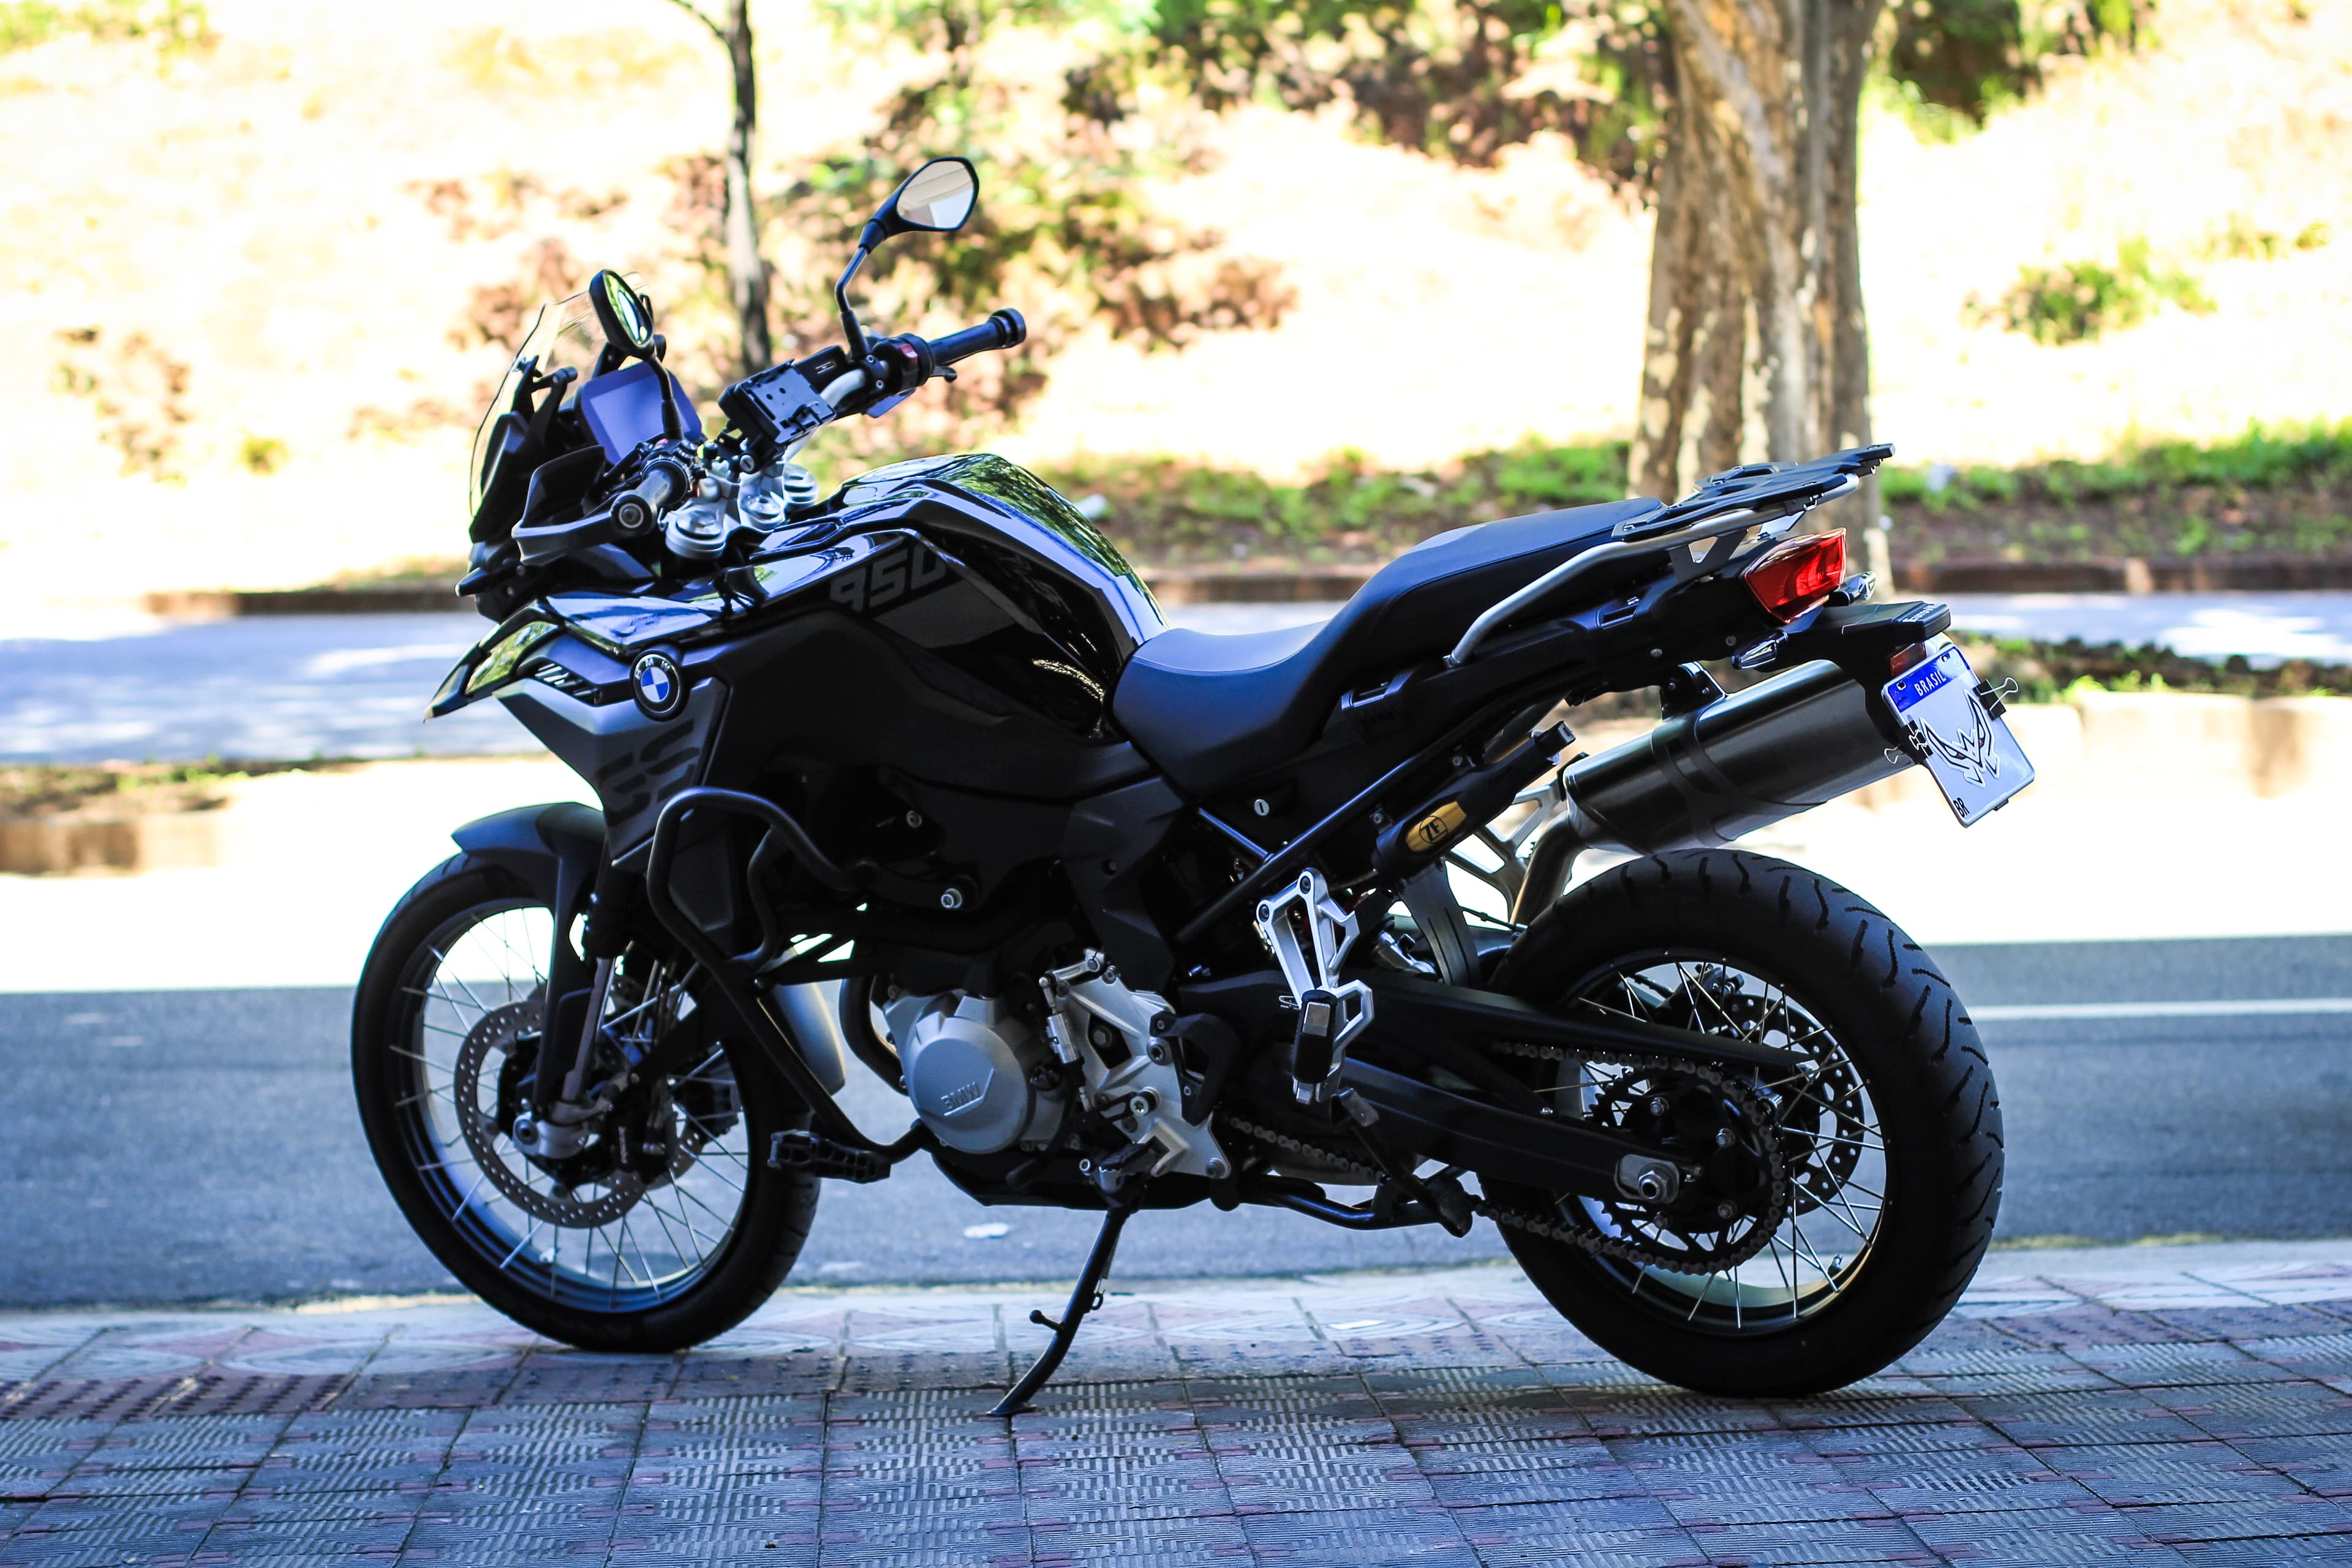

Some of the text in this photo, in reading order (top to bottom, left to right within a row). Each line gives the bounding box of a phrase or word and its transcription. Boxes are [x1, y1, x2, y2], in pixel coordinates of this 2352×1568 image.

[635, 658, 671, 680] BMW
[1914, 670, 1947, 696] BRASIL
[1953, 797, 1970, 818] BR
[1426, 820, 1441, 842] ZF
[941, 1082, 979, 1109] BMW
